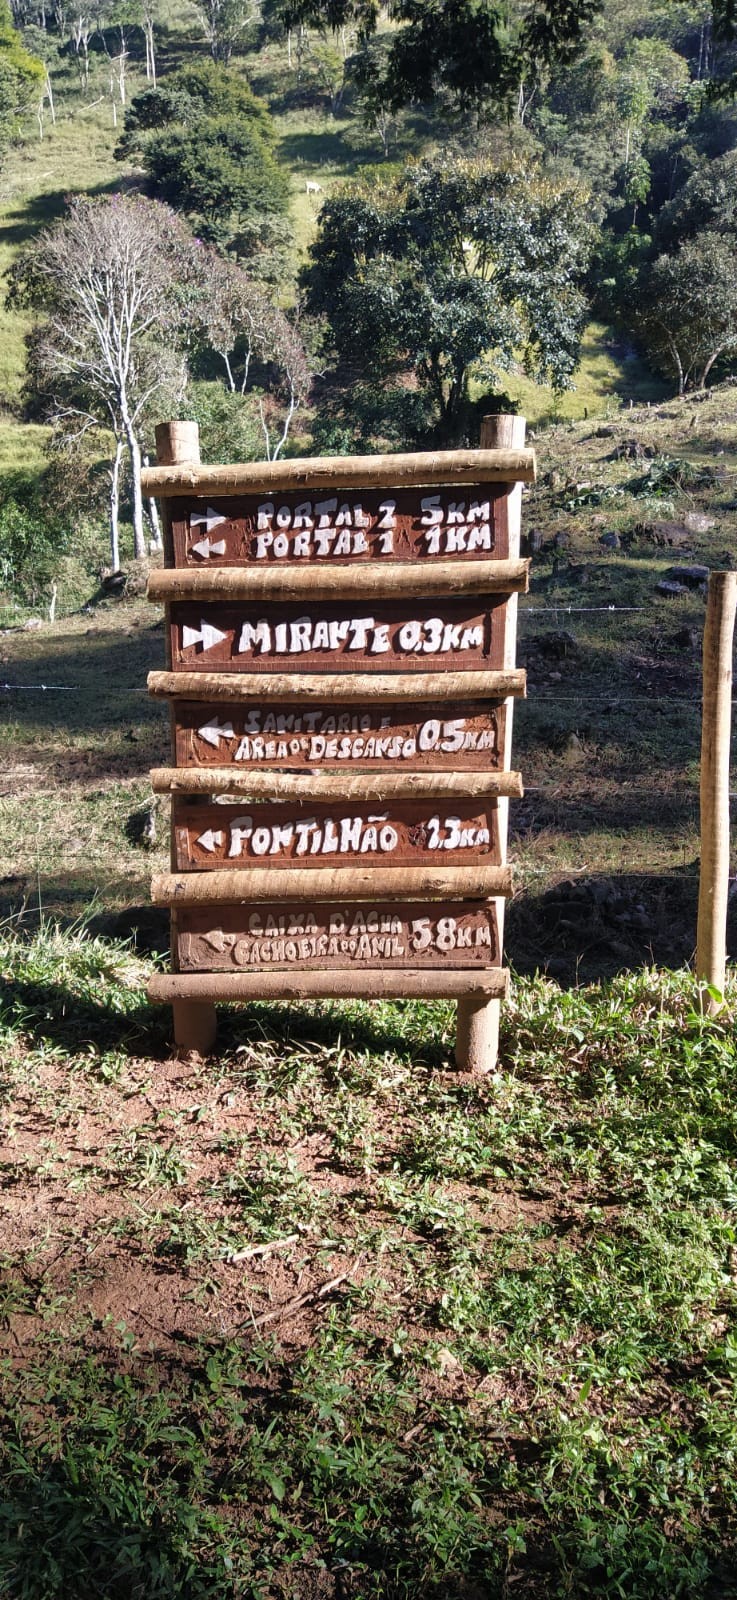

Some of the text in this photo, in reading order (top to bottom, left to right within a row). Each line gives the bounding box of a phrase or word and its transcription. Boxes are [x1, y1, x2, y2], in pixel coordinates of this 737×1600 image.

[257, 497, 370, 529] PORTAL
[378, 499, 397, 529] 2
[255, 528, 370, 559] PORTAL
[378, 530, 395, 554] 1
[238, 616, 390, 653] MIRANTE
[244, 710, 392, 735] SANITARIO E
[234, 736, 288, 761] AREA
[308, 735, 417, 761] DESCANSO
[228, 811, 398, 857] PONTILHÃO
[247, 912, 318, 937] CAIXA
[234, 934, 339, 966] CACHOEIRA
[354, 934, 405, 959] ANIL
